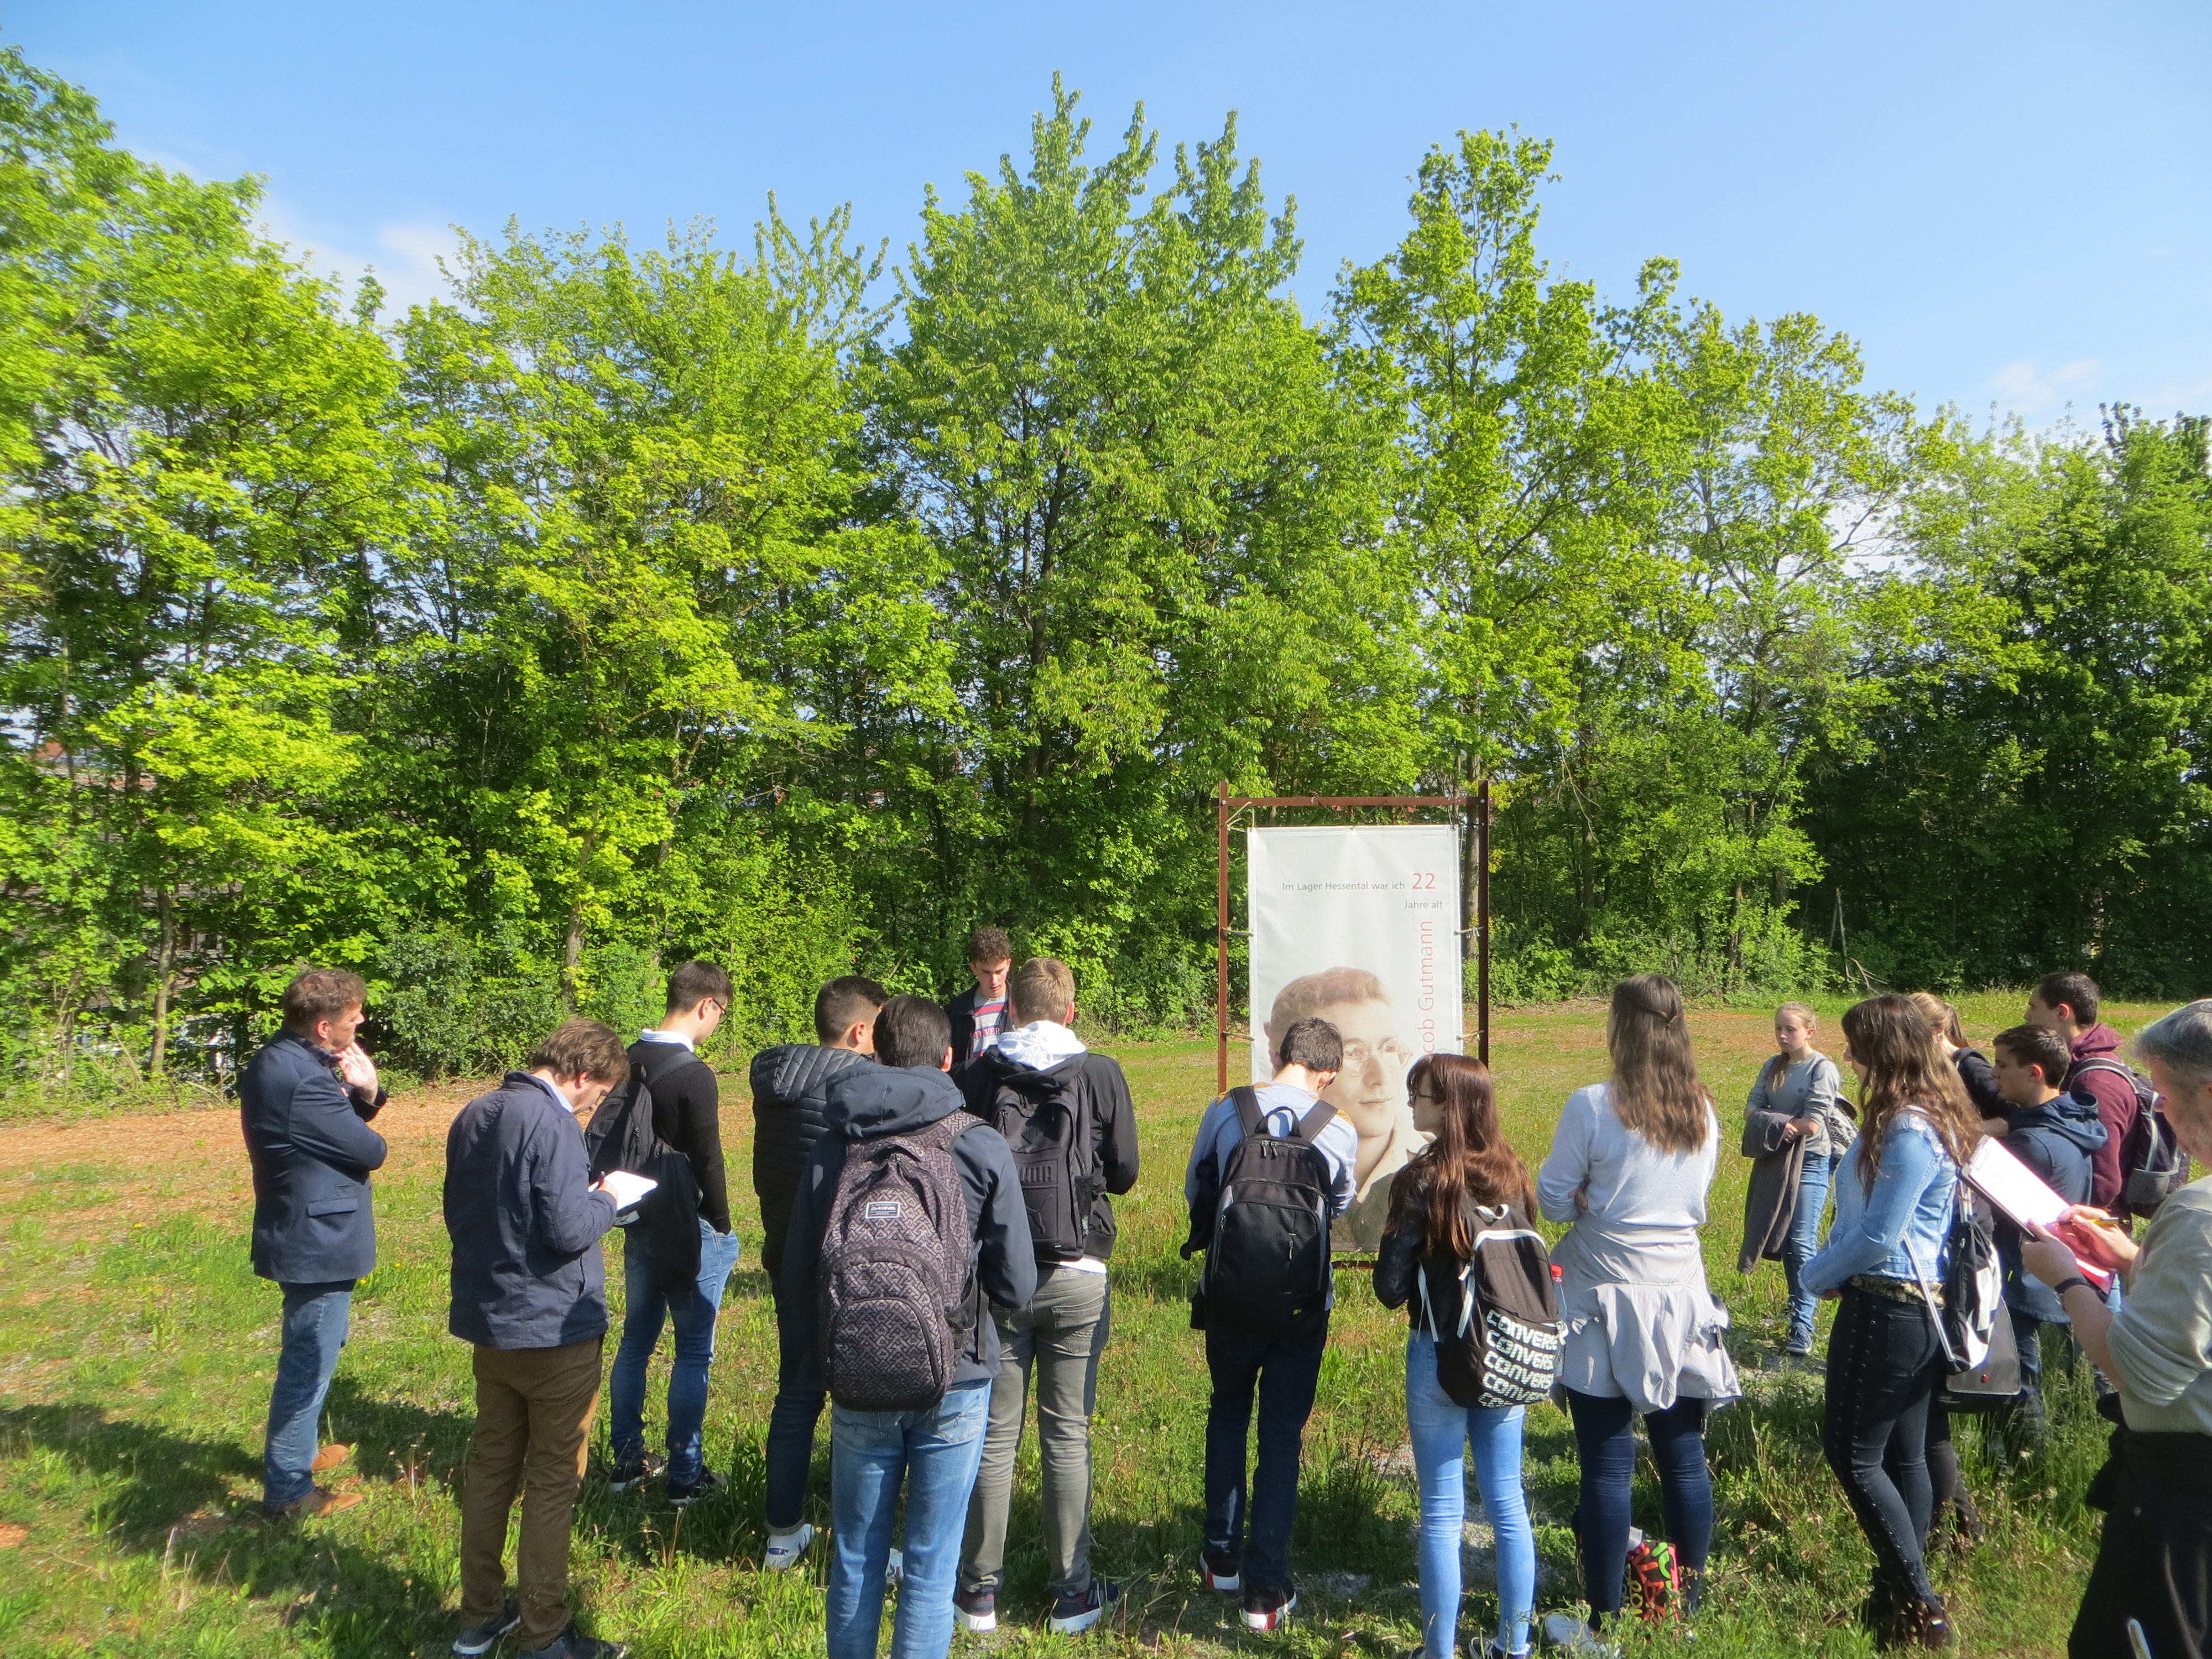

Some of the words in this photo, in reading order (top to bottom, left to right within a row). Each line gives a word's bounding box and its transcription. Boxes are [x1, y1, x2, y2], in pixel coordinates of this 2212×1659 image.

[1282, 883, 1294, 891] Im
[1297, 882, 1322, 893] Lager
[1325, 881, 1368, 890] Hessental
[1391, 881, 1405, 890] ich
[1412, 873, 1436, 890] 22
[1404, 901, 1428, 909] Jahre
[1431, 900, 1443, 909] alt
[1417, 921, 1434, 1011] Gutmann
